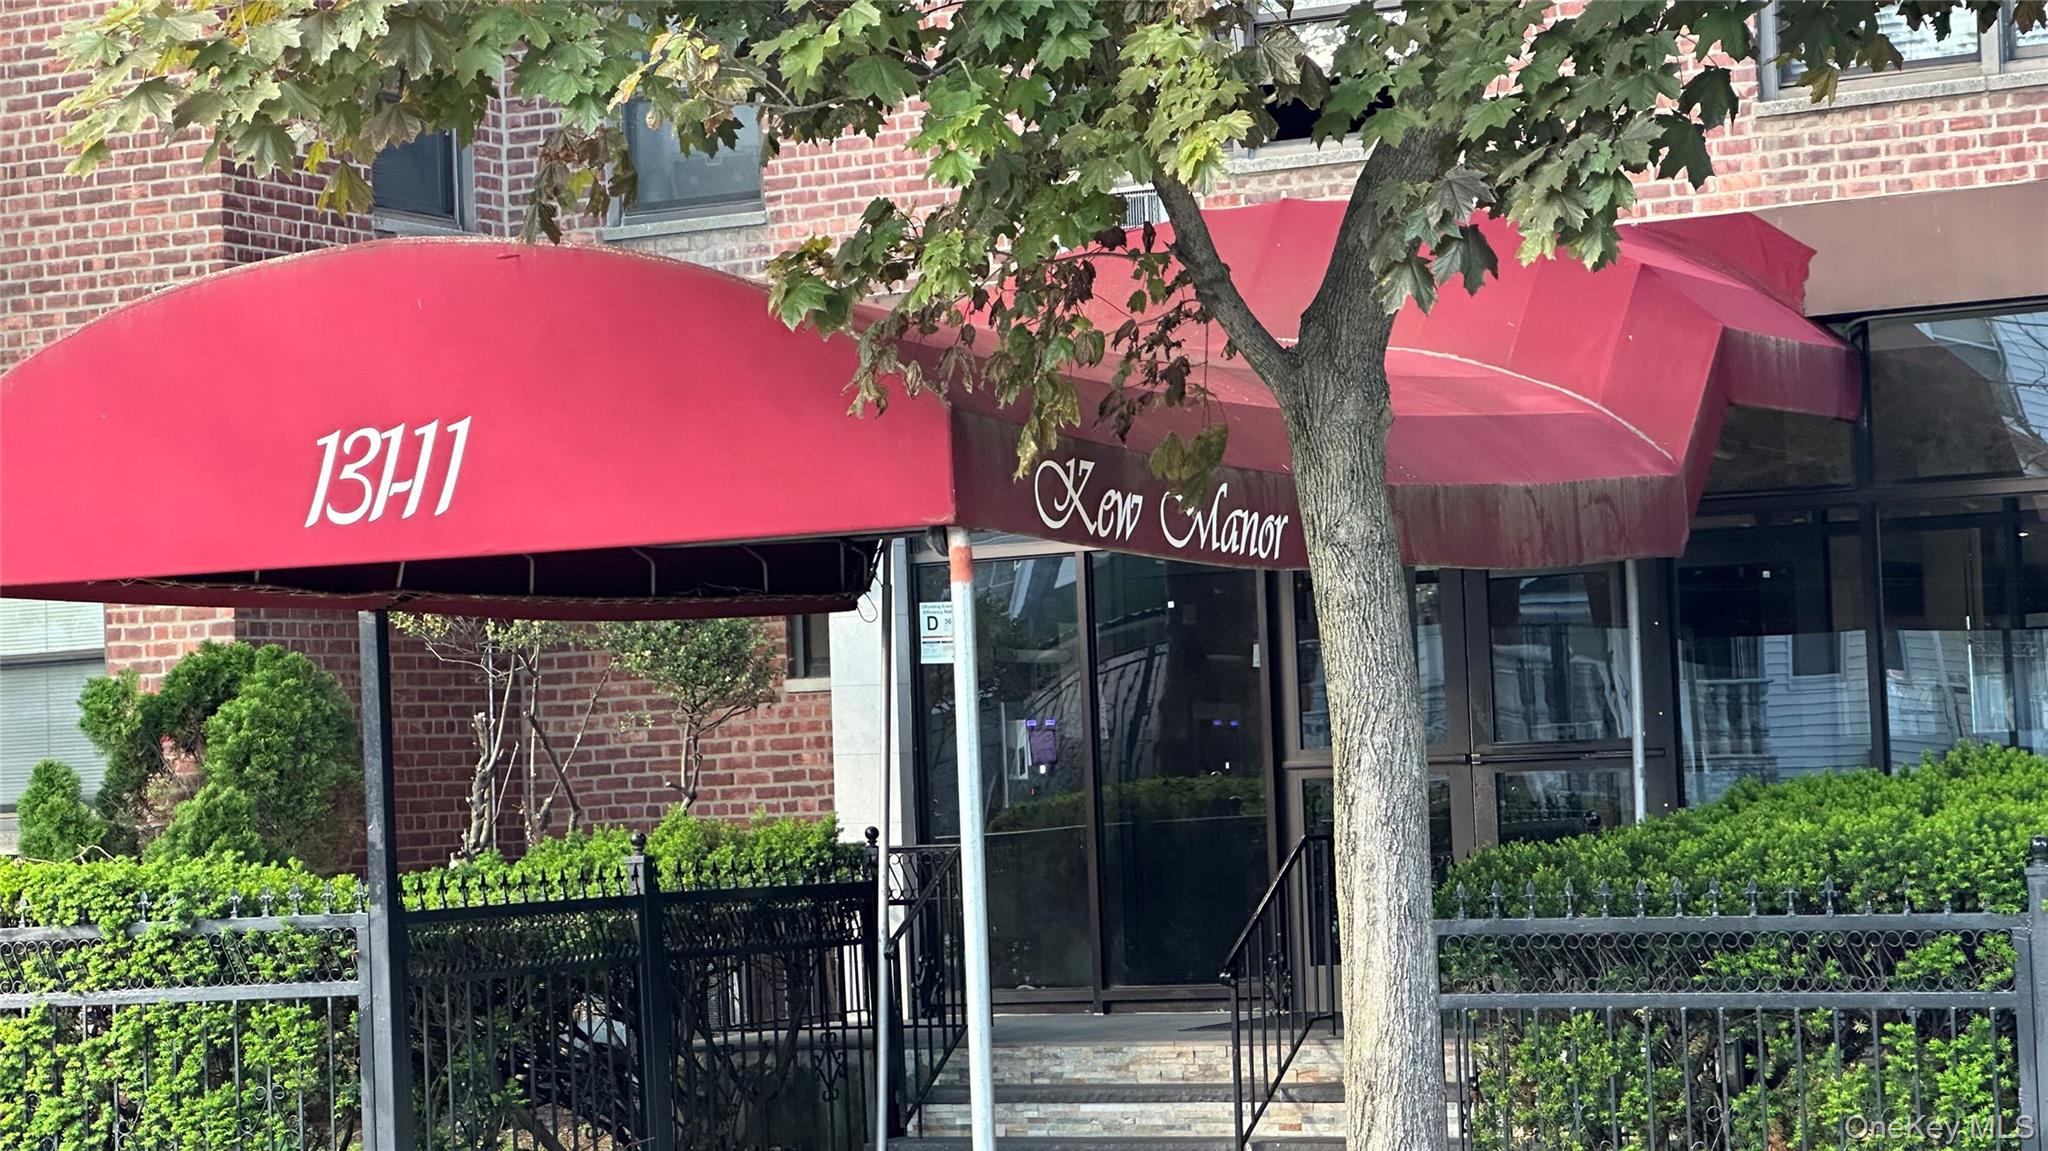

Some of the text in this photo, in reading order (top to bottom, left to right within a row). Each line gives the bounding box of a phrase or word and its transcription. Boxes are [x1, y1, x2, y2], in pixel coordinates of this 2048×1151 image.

[304, 415, 472, 528] 131-11
[1034, 457, 1289, 560] Kew Manor
[927, 615, 939, 631] D
